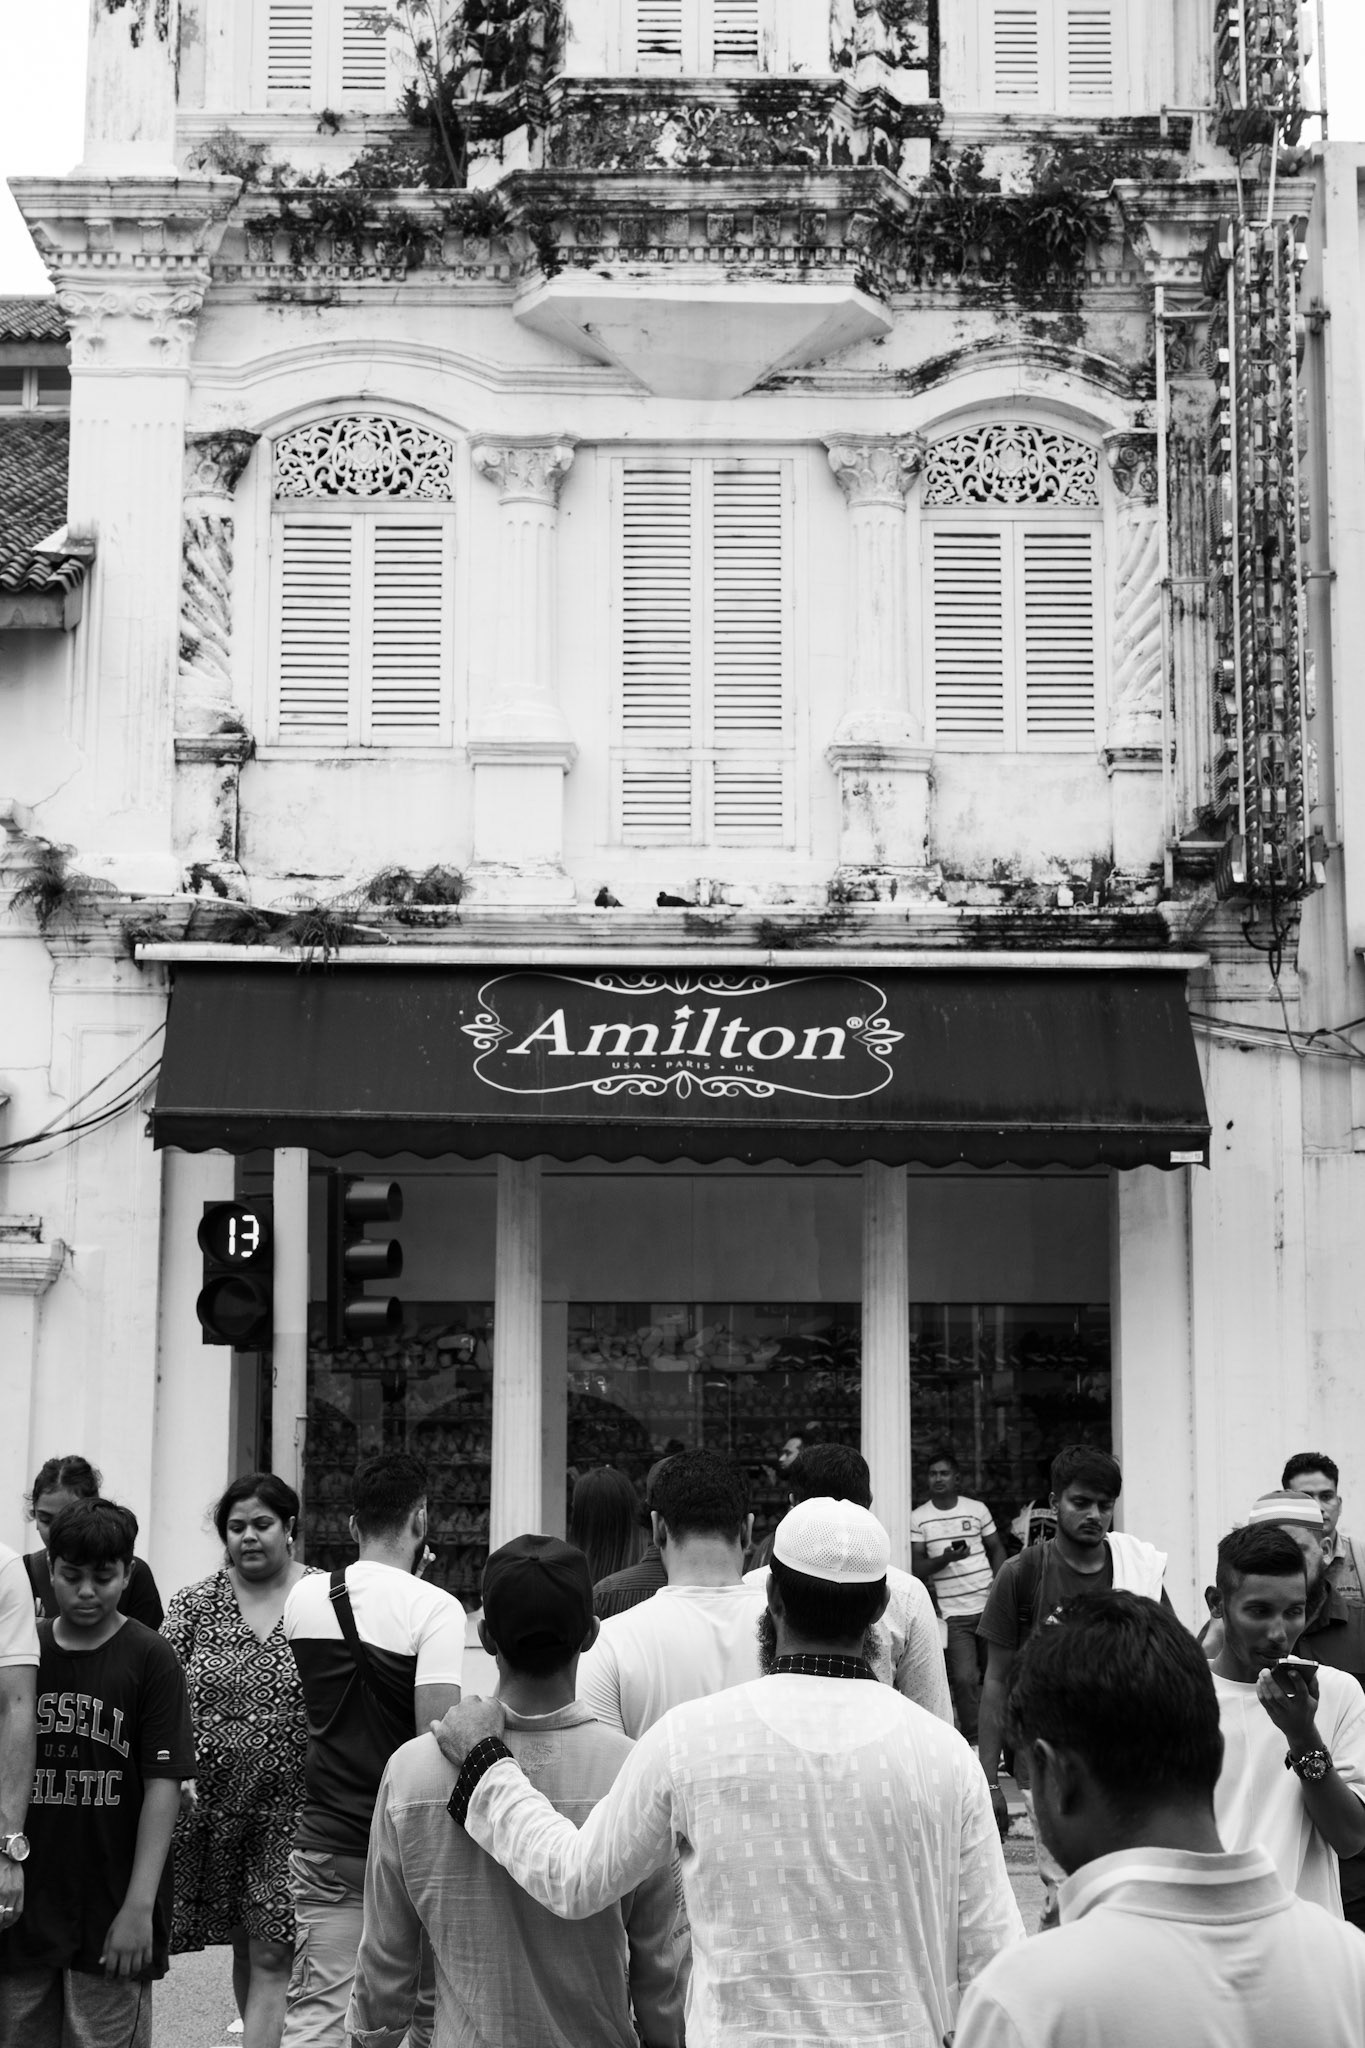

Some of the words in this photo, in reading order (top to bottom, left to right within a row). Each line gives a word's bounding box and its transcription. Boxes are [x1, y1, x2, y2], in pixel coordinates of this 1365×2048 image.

[611, 1060, 642, 1070] USA
[665, 1060, 711, 1071] PARIS
[734, 1063, 756, 1073] UK
[228, 1214, 260, 1258] 13
